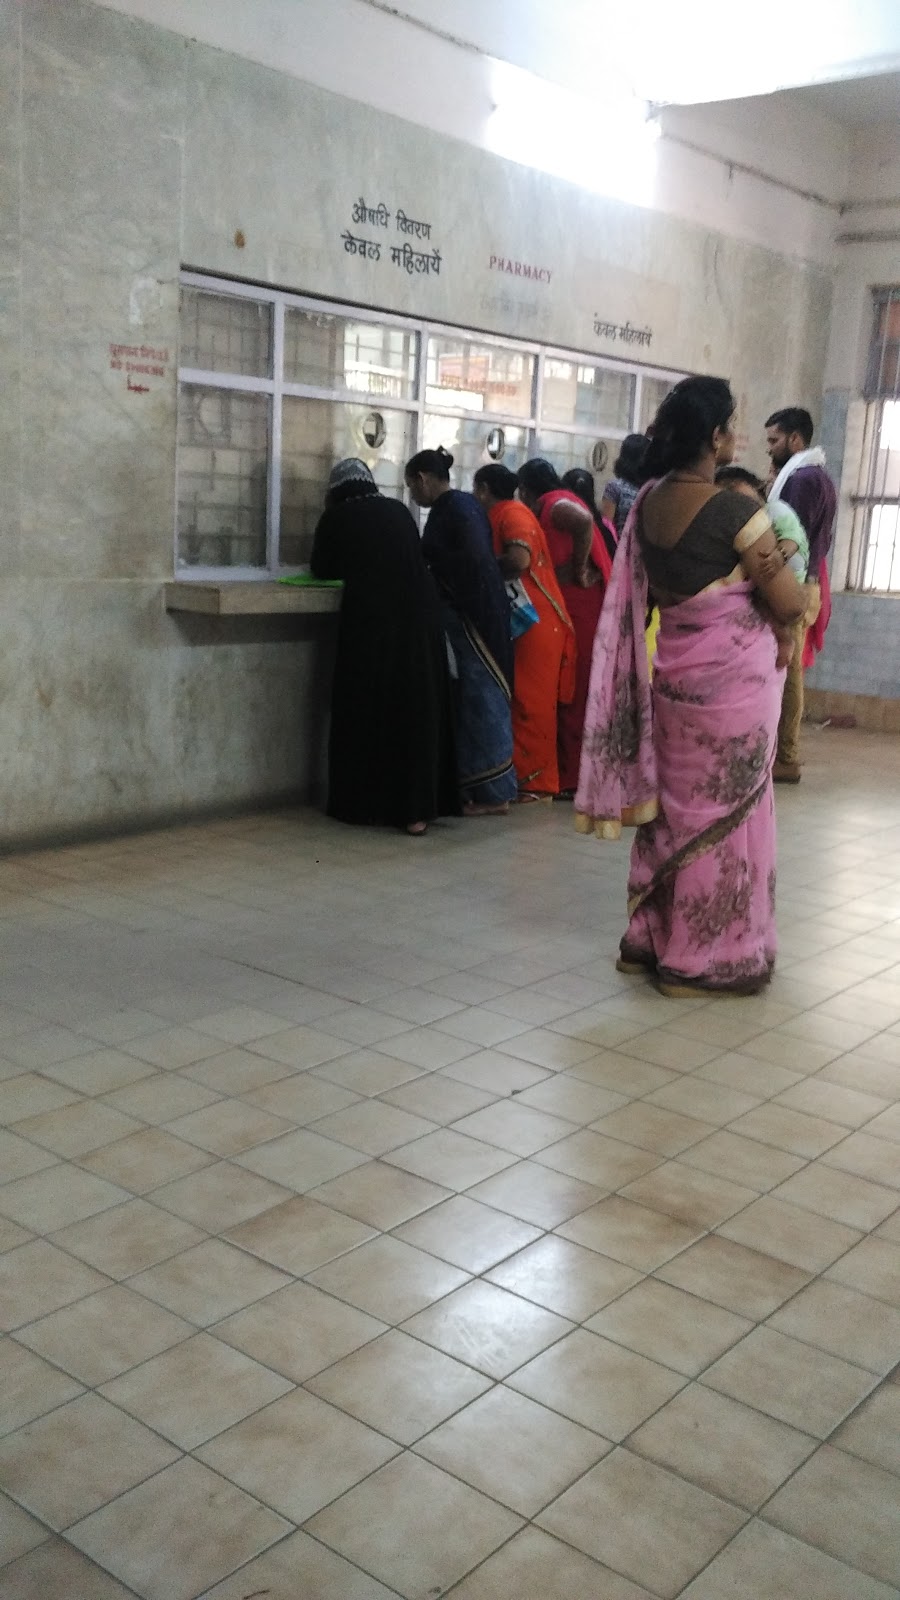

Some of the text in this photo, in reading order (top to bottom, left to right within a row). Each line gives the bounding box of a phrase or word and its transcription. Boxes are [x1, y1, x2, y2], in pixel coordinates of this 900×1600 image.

[351, 197, 431, 240] औषधि वितरण
[341, 230, 442, 275] केवल महिलायें
[489, 255, 552, 283] PHARMACY
